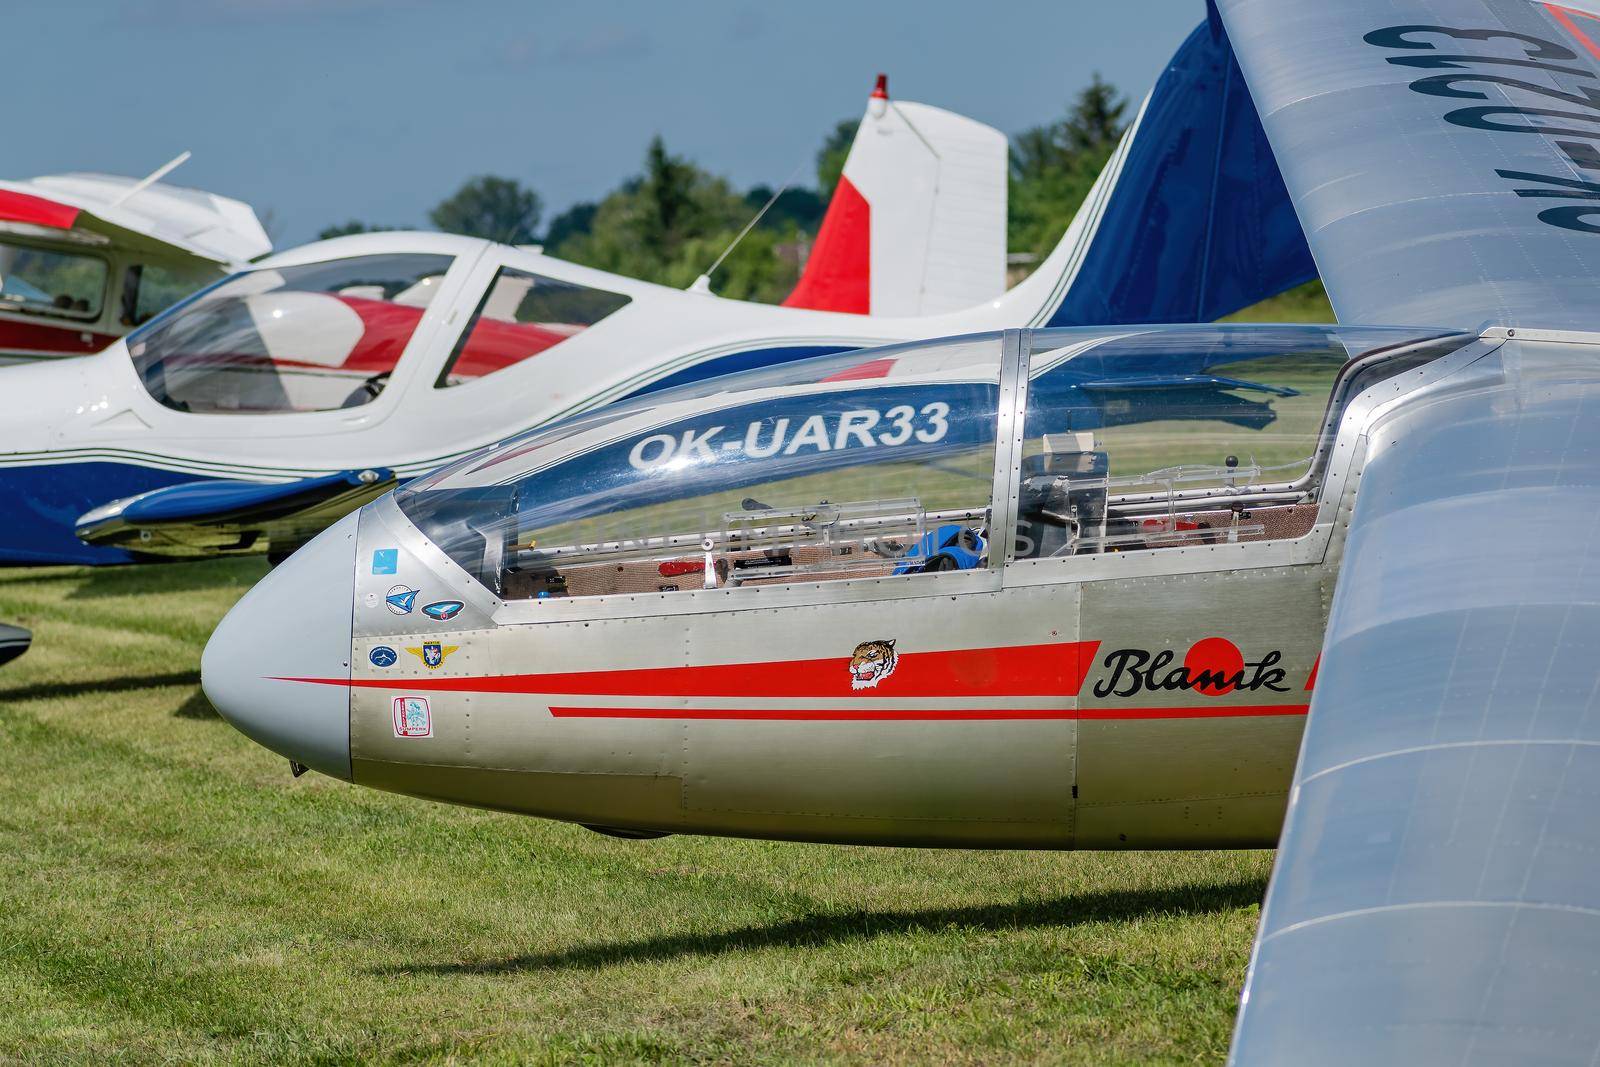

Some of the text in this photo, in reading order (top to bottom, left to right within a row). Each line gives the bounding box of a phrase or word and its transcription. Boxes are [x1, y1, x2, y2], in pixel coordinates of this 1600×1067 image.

[1363, 25, 1600, 234] -0213
[628, 402, 951, 472] OK-UAR33
[1093, 649, 1292, 698] Blanik
